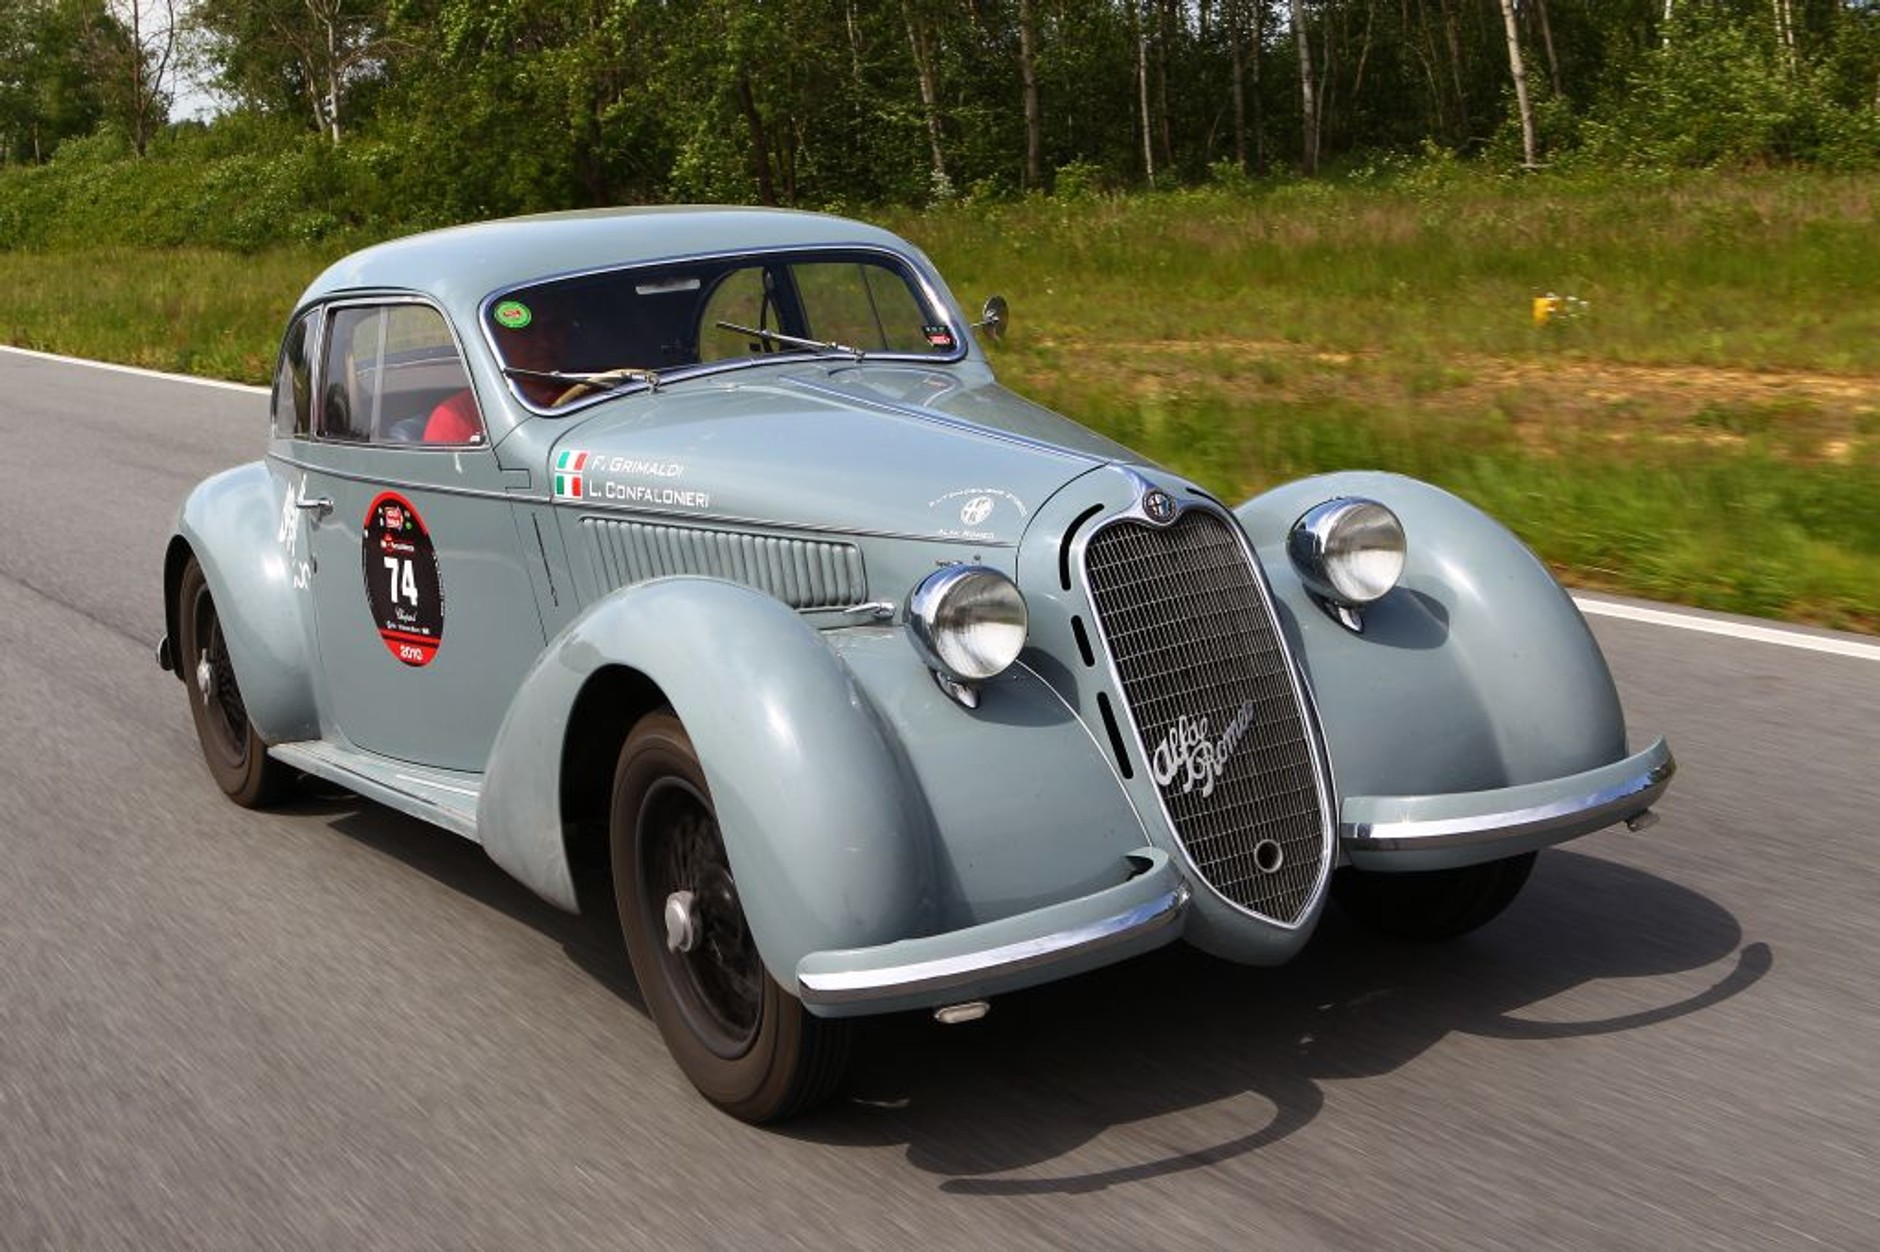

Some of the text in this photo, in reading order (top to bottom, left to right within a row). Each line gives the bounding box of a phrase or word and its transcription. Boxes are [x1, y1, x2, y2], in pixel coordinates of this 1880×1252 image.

[591, 456, 685, 478] F. GRIMALDI
[589, 479, 709, 508] L. CONFALONIERI
[384, 556, 418, 606] 74
[400, 645, 424, 661] 2010
[1153, 701, 1255, 797] Alfa Romeo
